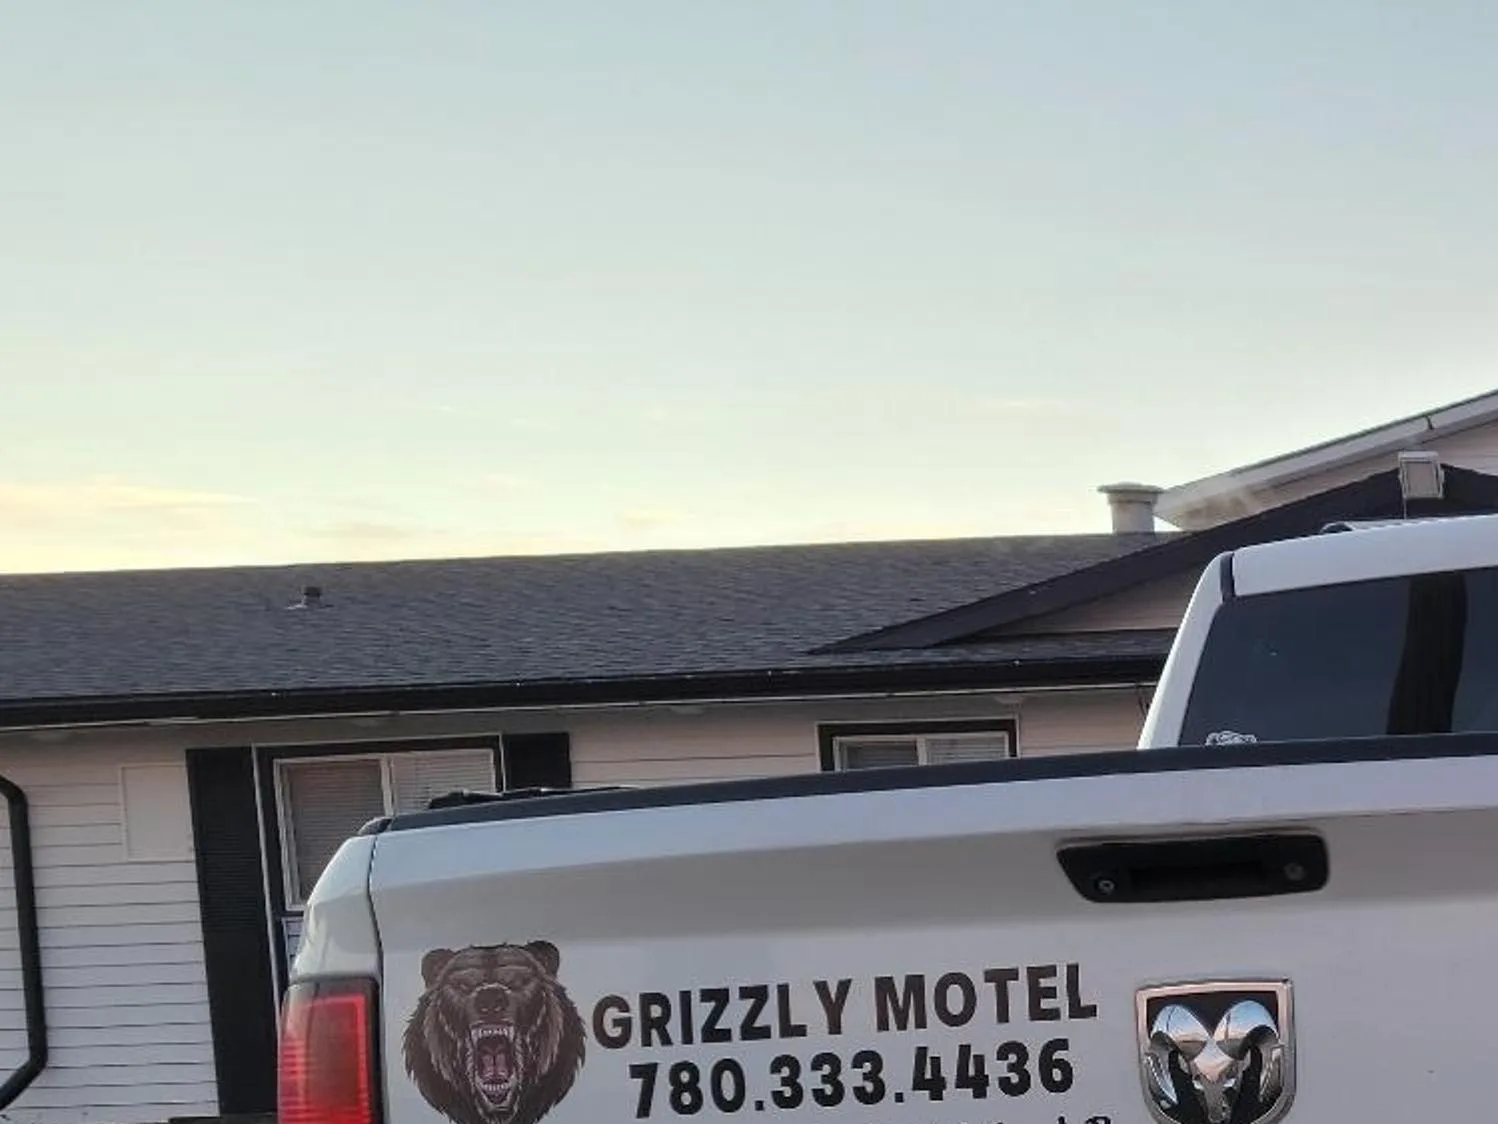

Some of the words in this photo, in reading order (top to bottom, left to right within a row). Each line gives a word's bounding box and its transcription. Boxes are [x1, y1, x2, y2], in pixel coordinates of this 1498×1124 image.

[592, 978, 853, 1050] GRIZZLY
[874, 963, 1098, 1033] MOTEL
[628, 1038, 1074, 1119] 780.333.4436
